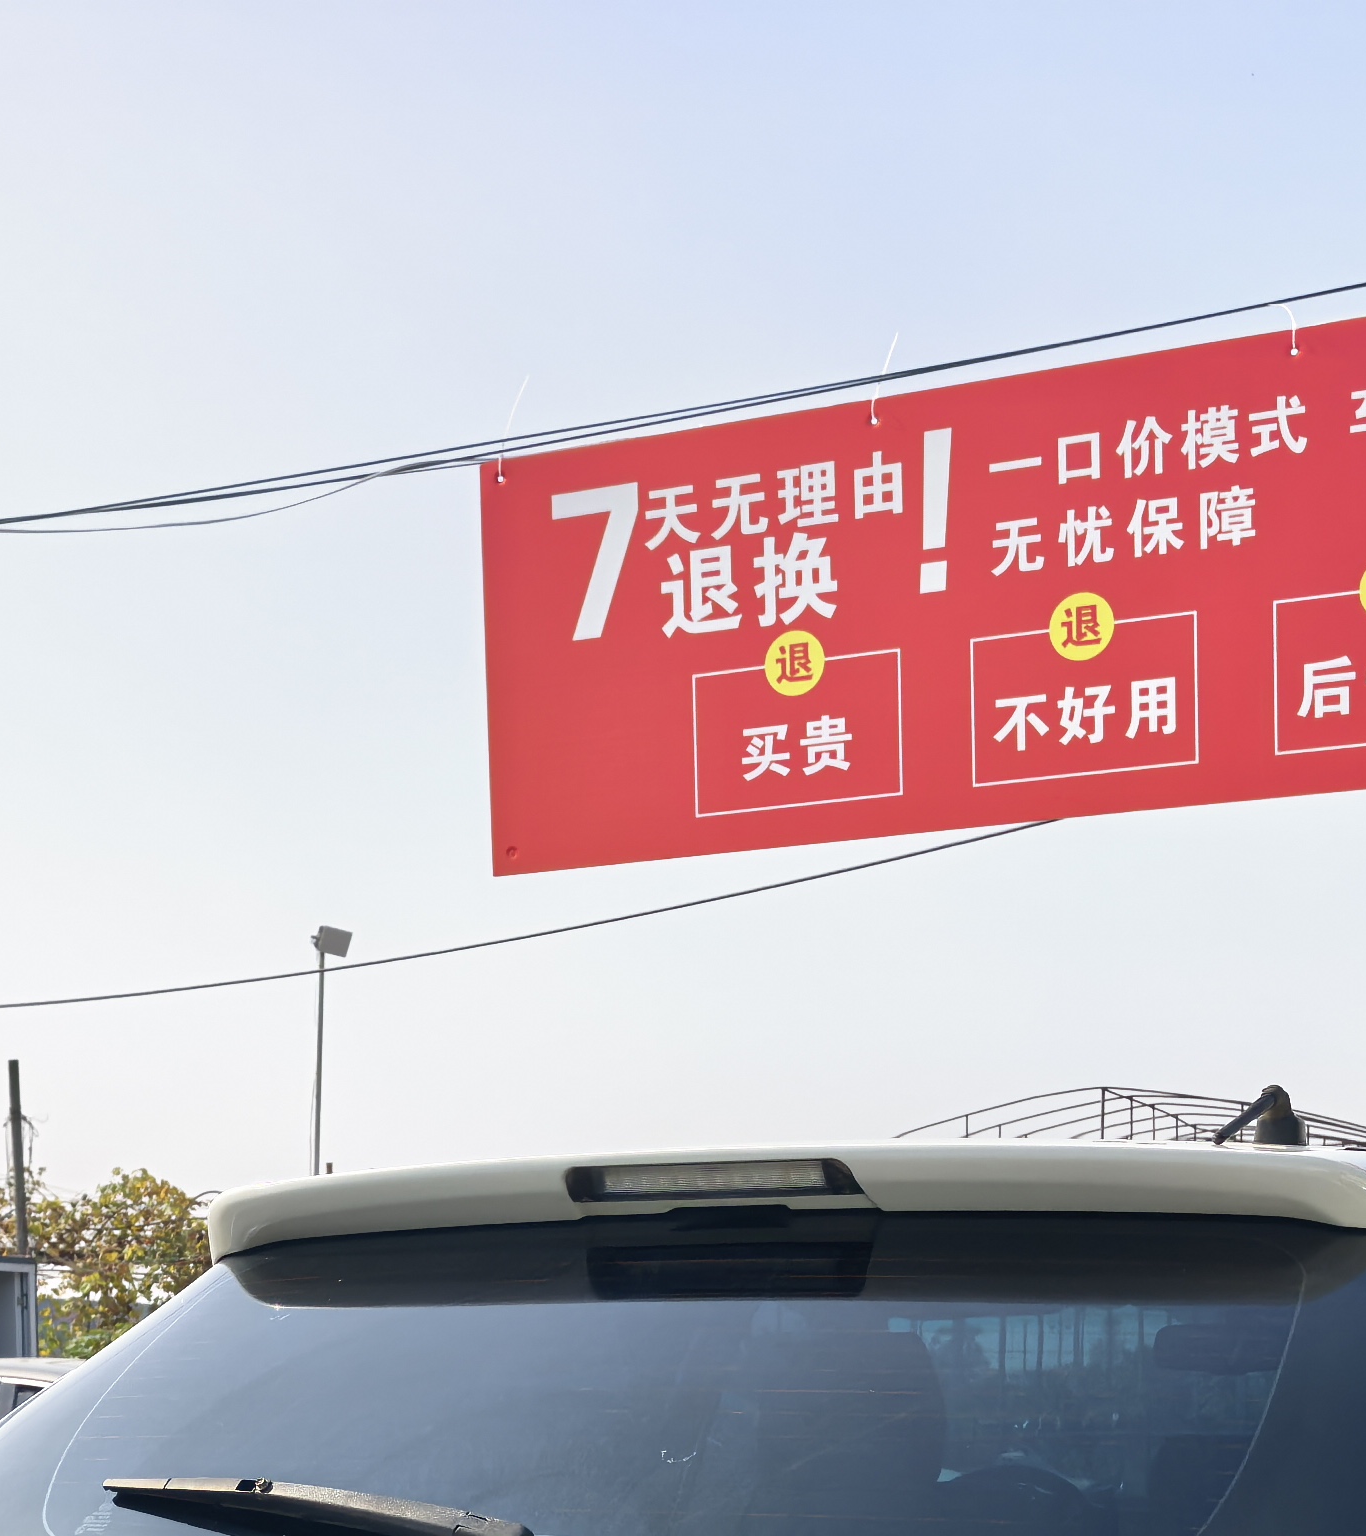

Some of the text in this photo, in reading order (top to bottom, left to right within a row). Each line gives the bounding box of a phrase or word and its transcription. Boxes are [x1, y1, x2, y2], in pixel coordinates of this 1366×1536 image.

[989, 395, 1307, 484] 一口价模式
[991, 485, 1255, 576] 无忧保障
[661, 532, 837, 638] 退换
[776, 643, 812, 683] 退
[1061, 605, 1101, 647] 退
[742, 715, 852, 781] 买贵
[994, 677, 1176, 751] 不好用
